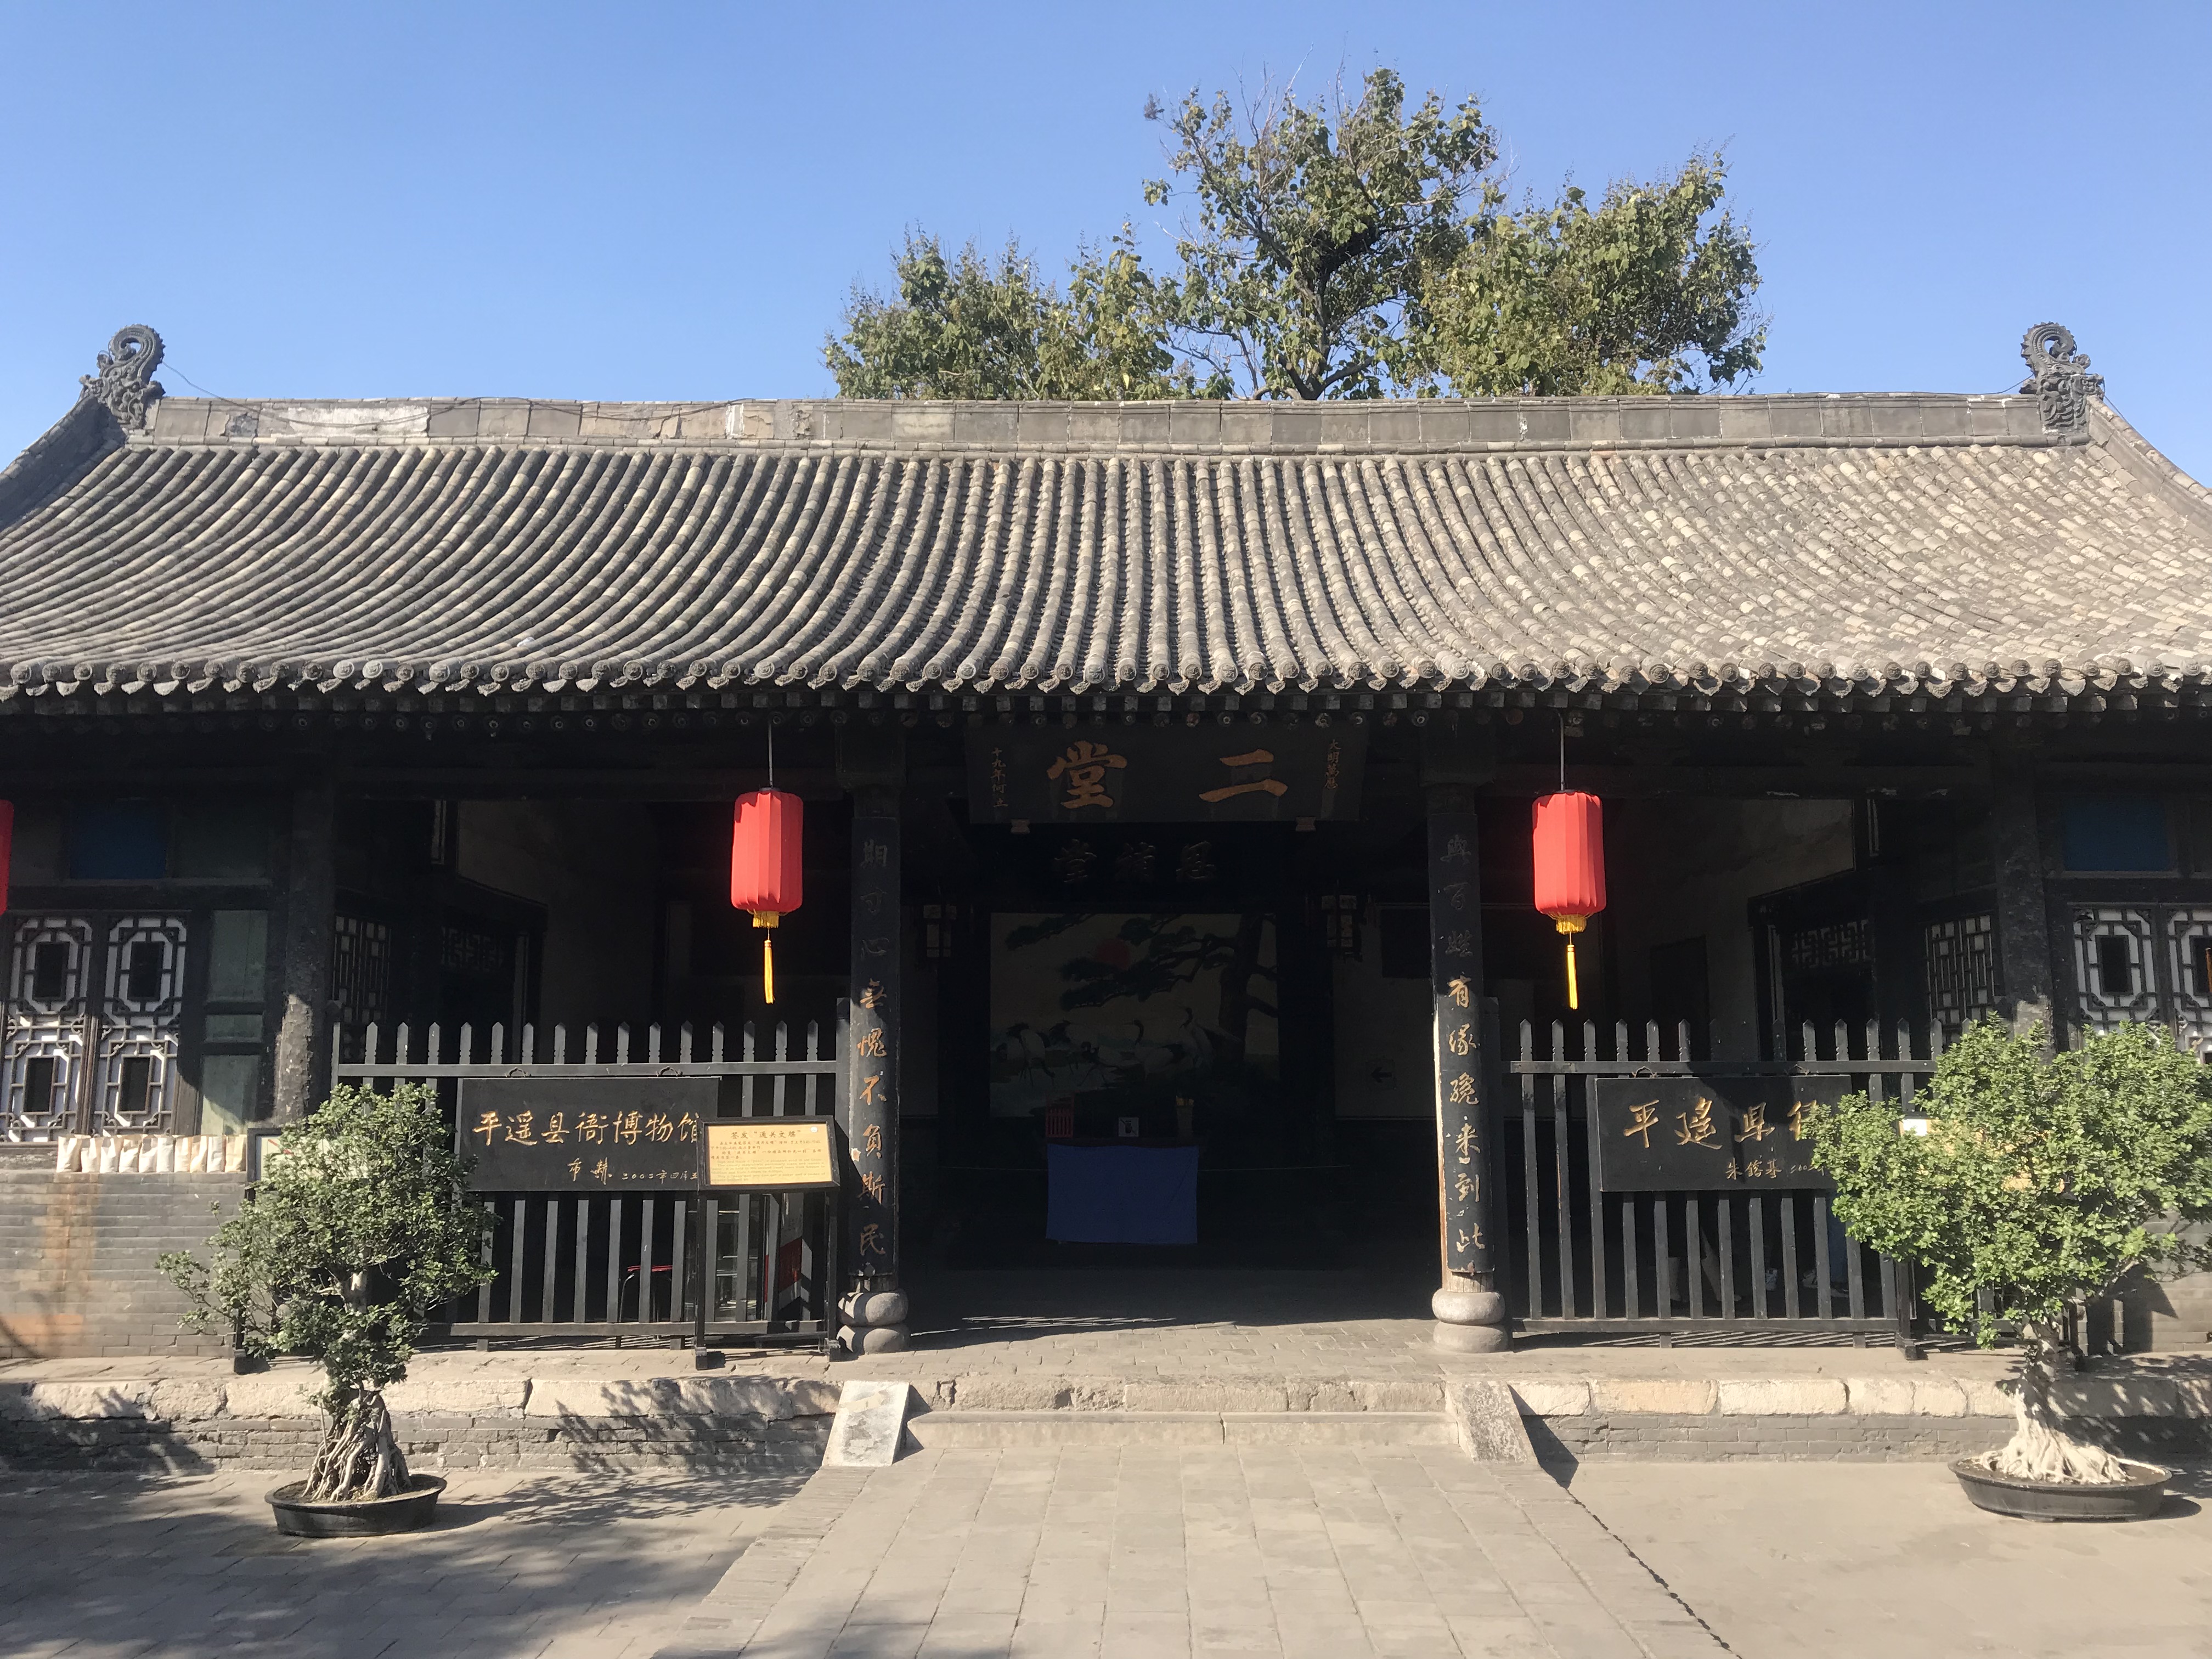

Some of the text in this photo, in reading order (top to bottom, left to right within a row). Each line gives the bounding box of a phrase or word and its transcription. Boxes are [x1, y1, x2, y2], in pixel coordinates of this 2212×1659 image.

[472, 1109, 699, 1146] 平遥县衙博物馆
